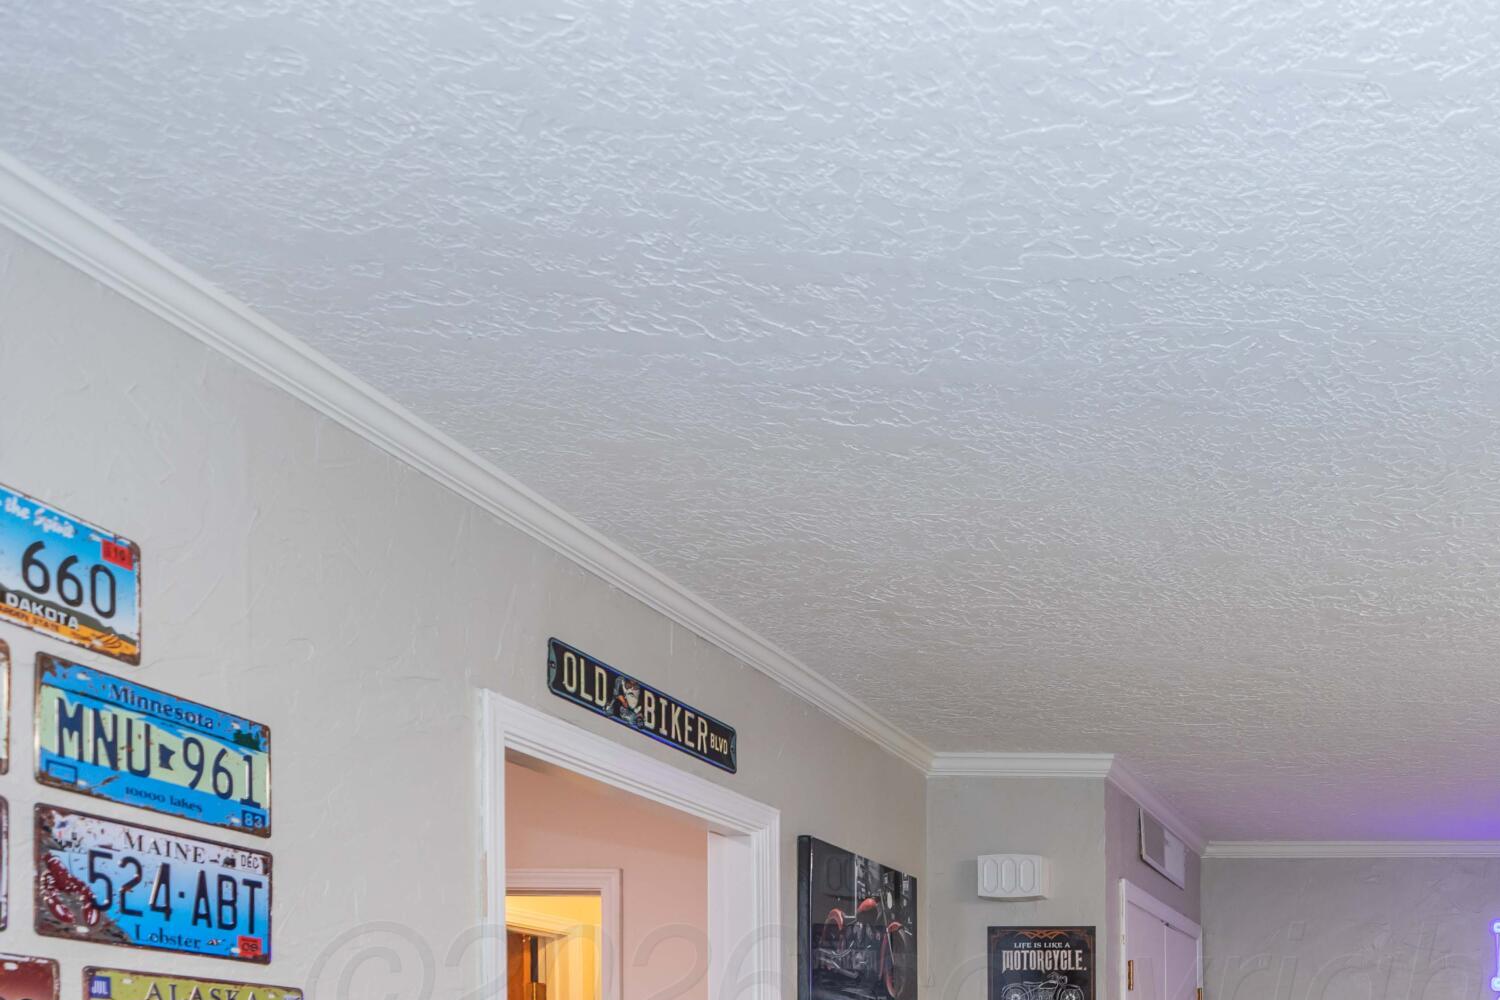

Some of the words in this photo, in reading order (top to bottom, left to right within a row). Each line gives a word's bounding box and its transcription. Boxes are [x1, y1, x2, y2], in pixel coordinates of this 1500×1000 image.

[5, 591, 80, 631] DAKOTA
[110, 683, 214, 730] Minnesota
[563, 652, 607, 707] OLD
[644, 690, 708, 754] BIKER
[710, 733, 728, 755] BLVD
[170, 794, 203, 813] lakes
[244, 812, 263, 829] 83
[123, 831, 205, 865] MAINE
[240, 854, 260, 869] DEC
[134, 924, 200, 950] Lobster
[1002, 949, 1087, 972] MOTORCYCLE.
